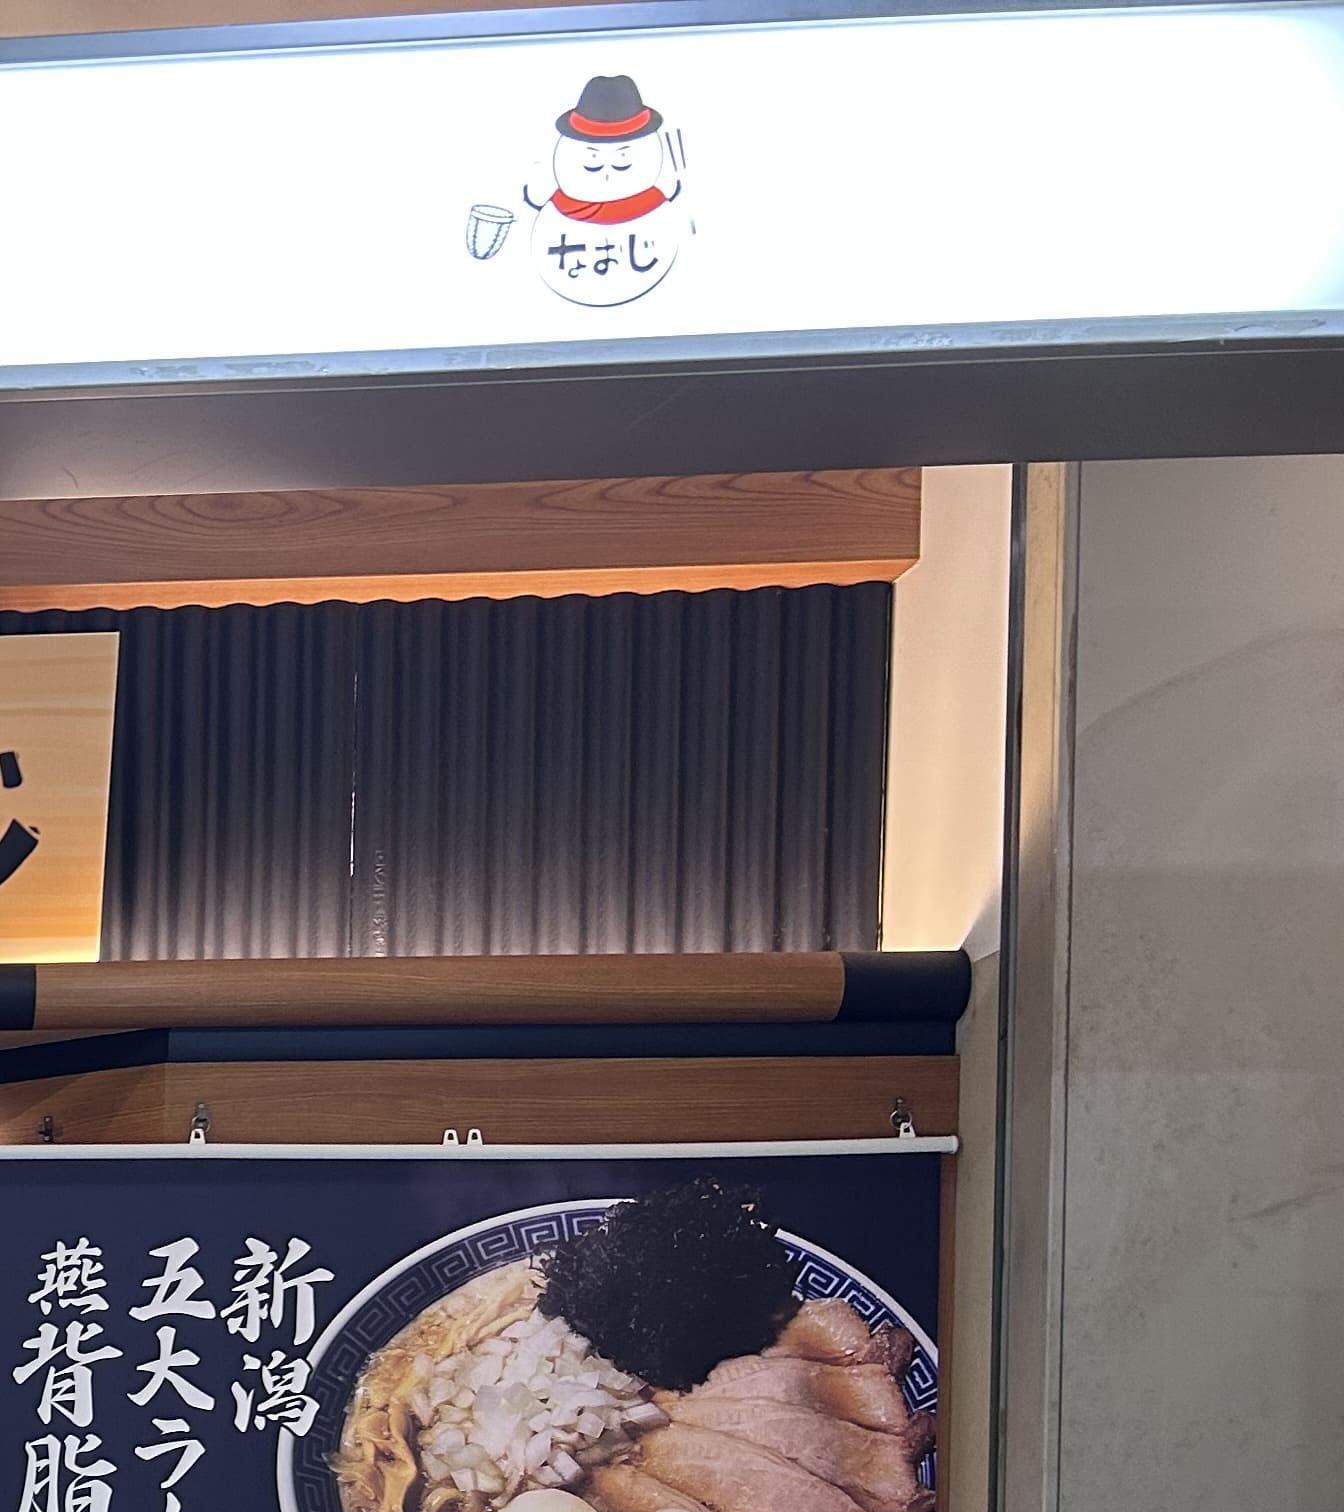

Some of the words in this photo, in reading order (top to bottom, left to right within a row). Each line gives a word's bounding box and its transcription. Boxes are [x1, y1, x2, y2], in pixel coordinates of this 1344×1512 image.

[547, 233, 659, 279] なおじ
[219, 1236, 337, 1439] 新潟
